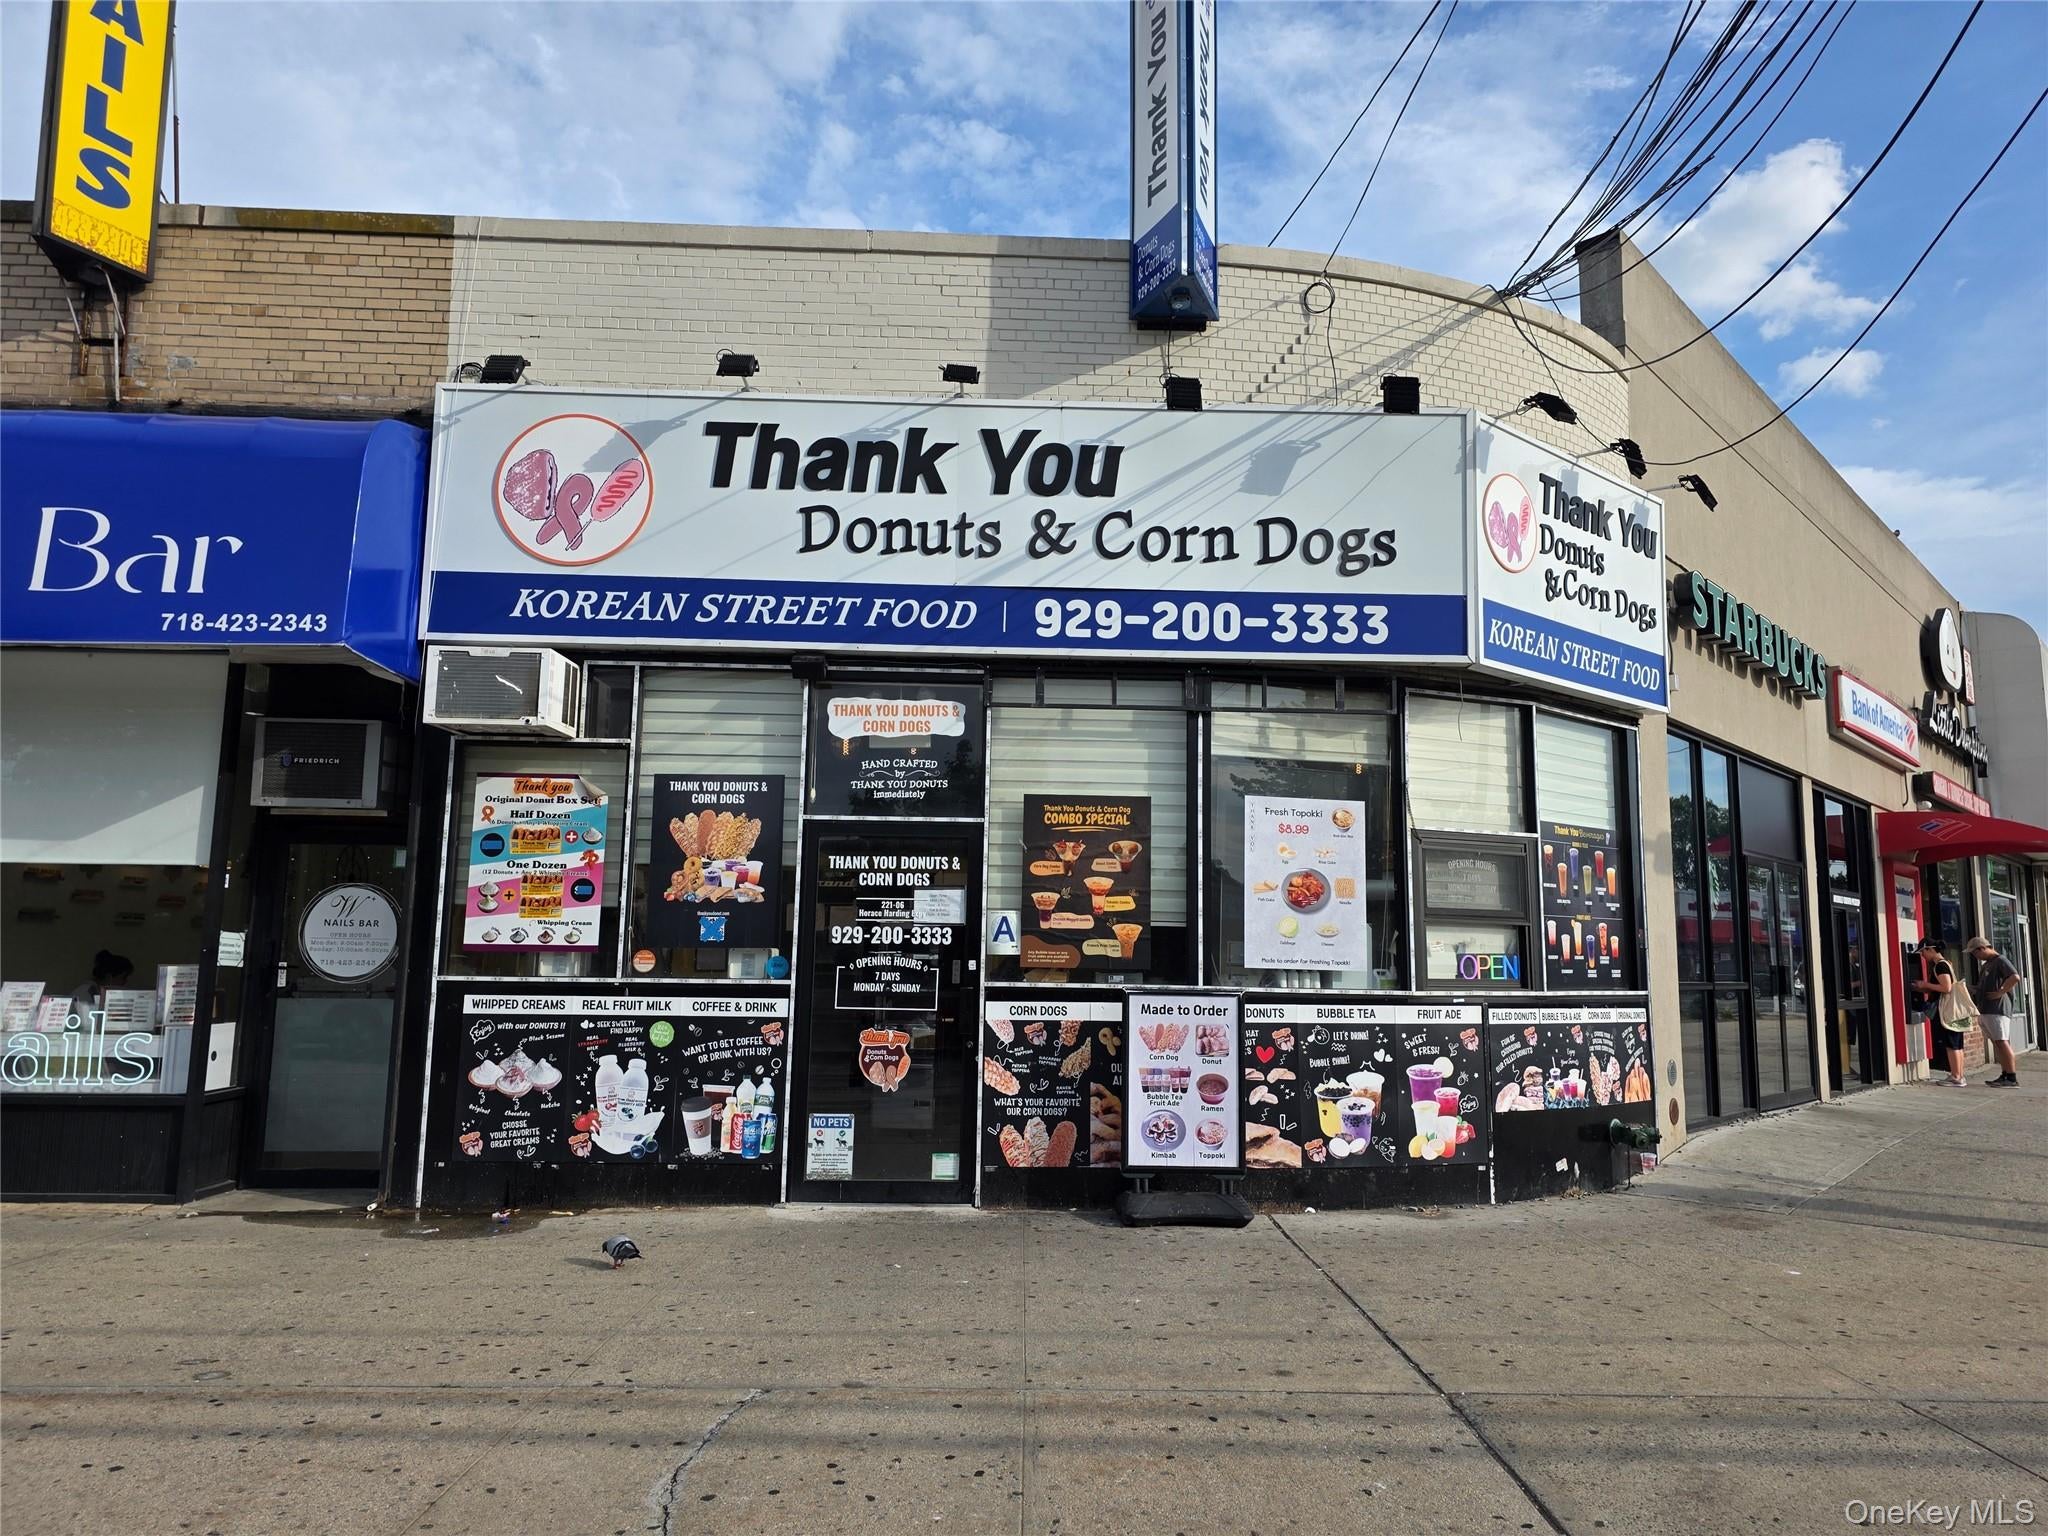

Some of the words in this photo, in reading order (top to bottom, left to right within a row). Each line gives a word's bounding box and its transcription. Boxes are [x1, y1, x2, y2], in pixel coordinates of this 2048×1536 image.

[1147, 6, 1166, 87] You
[1147, 82, 1167, 207] Thank
[704, 421, 959, 494] Thank
[977, 428, 1124, 498] You
[1539, 472, 1614, 541] Thank
[1617, 508, 1657, 560] You
[797, 505, 1002, 559] Donuts
[1026, 508, 1077, 560] &
[1096, 510, 1239, 564] Corn
[1256, 516, 1398, 577] Dogs
[28, 507, 243, 594] Bar
[1539, 523, 1605, 577] Donuts
[510, 588, 690, 622] KOREAN
[695, 593, 863, 628] STREET
[864, 598, 978, 631] FOOD
[1034, 598, 1390, 645] 929-200-3333
[1614, 589, 1657, 632] Dogs
[160, 612, 328, 633] 718-423-2343
[1690, 570, 1828, 701] STARBUCKS
[1488, 618, 1559, 662] KOREAN
[1562, 640, 1620, 680] STREET
[1622, 659, 1661, 691] FOOD
[833, 704, 872, 717] THANK
[874, 704, 900, 717] YOU
[903, 705, 949, 717] DONUTS
[952, 705, 960, 717] &
[1851, 689, 1872, 723] Bank
[1871, 703, 1879, 726] of
[1879, 705, 1904, 742] America
[863, 720, 895, 732] CORN
[899, 720, 931, 733] DOGS
[293, 756, 341, 765] FRIEDRICH
[861, 759, 890, 769] HAND
[892, 758, 938, 768] CRAFTED
[895, 768, 906, 779] by
[515, 778, 549, 792] Thank
[551, 780, 572, 795] you
[669, 781, 700, 792] THANK
[702, 781, 720, 792] YOU
[722, 781, 759, 792] DONUTS
[761, 782, 768, 792] &
[851, 780, 885, 789] THANK
[887, 779, 908, 789] YOU
[909, 780, 949, 789] DONUTS
[485, 795, 524, 805] Original
[525, 796, 554, 805] Donut
[556, 795, 578, 805] Box
[692, 793, 717, 804] CORN
[719, 793, 745, 804] DOGS
[873, 789, 926, 800] immediately
[510, 810, 534, 820] Half
[536, 811, 571, 820] Dozen
[1043, 804, 1062, 812] Thank
[1075, 805, 1096, 813] Donuts
[1119, 806, 1131, 815] Dog
[1264, 807, 1289, 816] Fresh
[1290, 808, 1323, 819] Topokki
[1044, 812, 1083, 824] COMBO
[1085, 813, 1131, 825] SPECIAL
[1278, 822, 1310, 835] $8.99
[507, 860, 529, 869] One
[532, 860, 567, 870] Dozen
[828, 855, 870, 869] THANK
[873, 856, 897, 869] YOU
[901, 856, 949, 870] DONUTS
[952, 856, 961, 870] &
[858, 873, 893, 886] CORN
[896, 873, 930, 887] DOGS
[331, 894, 371, 917] W
[881, 901, 905, 909] 221-06
[858, 909, 882, 918] Horace
[884, 909, 910, 918] Harding
[323, 919, 354, 927] NAILS
[358, 919, 380, 928] BAR
[537, 919, 569, 927] Whipping
[992, 915, 1015, 942] A
[831, 926, 953, 946] 929-200-3333
[856, 955, 892, 969] OPENING
[893, 956, 923, 972] HOURS
[1460, 954, 1519, 980] OPEN
[875, 971, 880, 981] 7
[881, 971, 901, 981] DAYS
[853, 982, 885, 993] MONDAY
[891, 982, 922, 993] SUNDAY
[472, 998, 519, 1010] WHIPPED
[521, 999, 566, 1010] CREAMS
[582, 1000, 610, 1010] REAL
[613, 1000, 644, 1010] FRUIT
[646, 1001, 672, 1011] MILK
[692, 1001, 732, 1012] COFFEE
[734, 1002, 742, 1012] &
[745, 1002, 777, 1013] DRINK
[1140, 1003, 1174, 1015] Made
[1177, 1004, 1190, 1016] to
[1193, 1004, 1229, 1017] Order
[1009, 1005, 1037, 1016] CORN
[1040, 1005, 1068, 1016] DOGS
[1246, 1008, 1285, 1018] DONUTS
[1317, 1008, 1354, 1019] BUBBLE
[1357, 1009, 1376, 1019] TEA
[1417, 1009, 1443, 1020] FRUIT
[1445, 1009, 1462, 1020] ADE
[1492, 1012, 1512, 1021] FILLED
[1513, 1012, 1537, 1021] DONUTS
[497, 1022, 514, 1030] with
[528, 1022, 558, 1030] DONUTS
[1, 1010, 154, 1087] ails
[682, 1044, 706, 1057] WANT
[707, 1041, 719, 1051] TO
[719, 1038, 735, 1049] GET
[736, 1036, 764, 1047] COFFEE
[698, 1054, 709, 1064] OR
[710, 1051, 733, 1062] DRINK
[734, 1048, 756, 1059] WITH
[756, 1046, 772, 1057] US?
[1166, 1054, 1179, 1062] Dog
[1201, 1057, 1222, 1065] Donut
[994, 1097, 1023, 1106] WHAT'S
[1024, 1098, 1044, 1107] YOUR
[1045, 1097, 1081, 1107] FAVORITE
[1006, 1107, 1022, 1116] OUR
[1022, 1108, 1043, 1116] CORN
[1043, 1107, 1068, 1116] DOGS?
[813, 1117, 826, 1127] NO
[828, 1117, 850, 1127] PETS
[490, 1130, 507, 1139] YOUR
[508, 1127, 540, 1138] FAVORITE
[490, 1138, 511, 1148] GREAT
[512, 1136, 540, 1147] CREAMS
[1198, 1151, 1226, 1160] Toppoki
